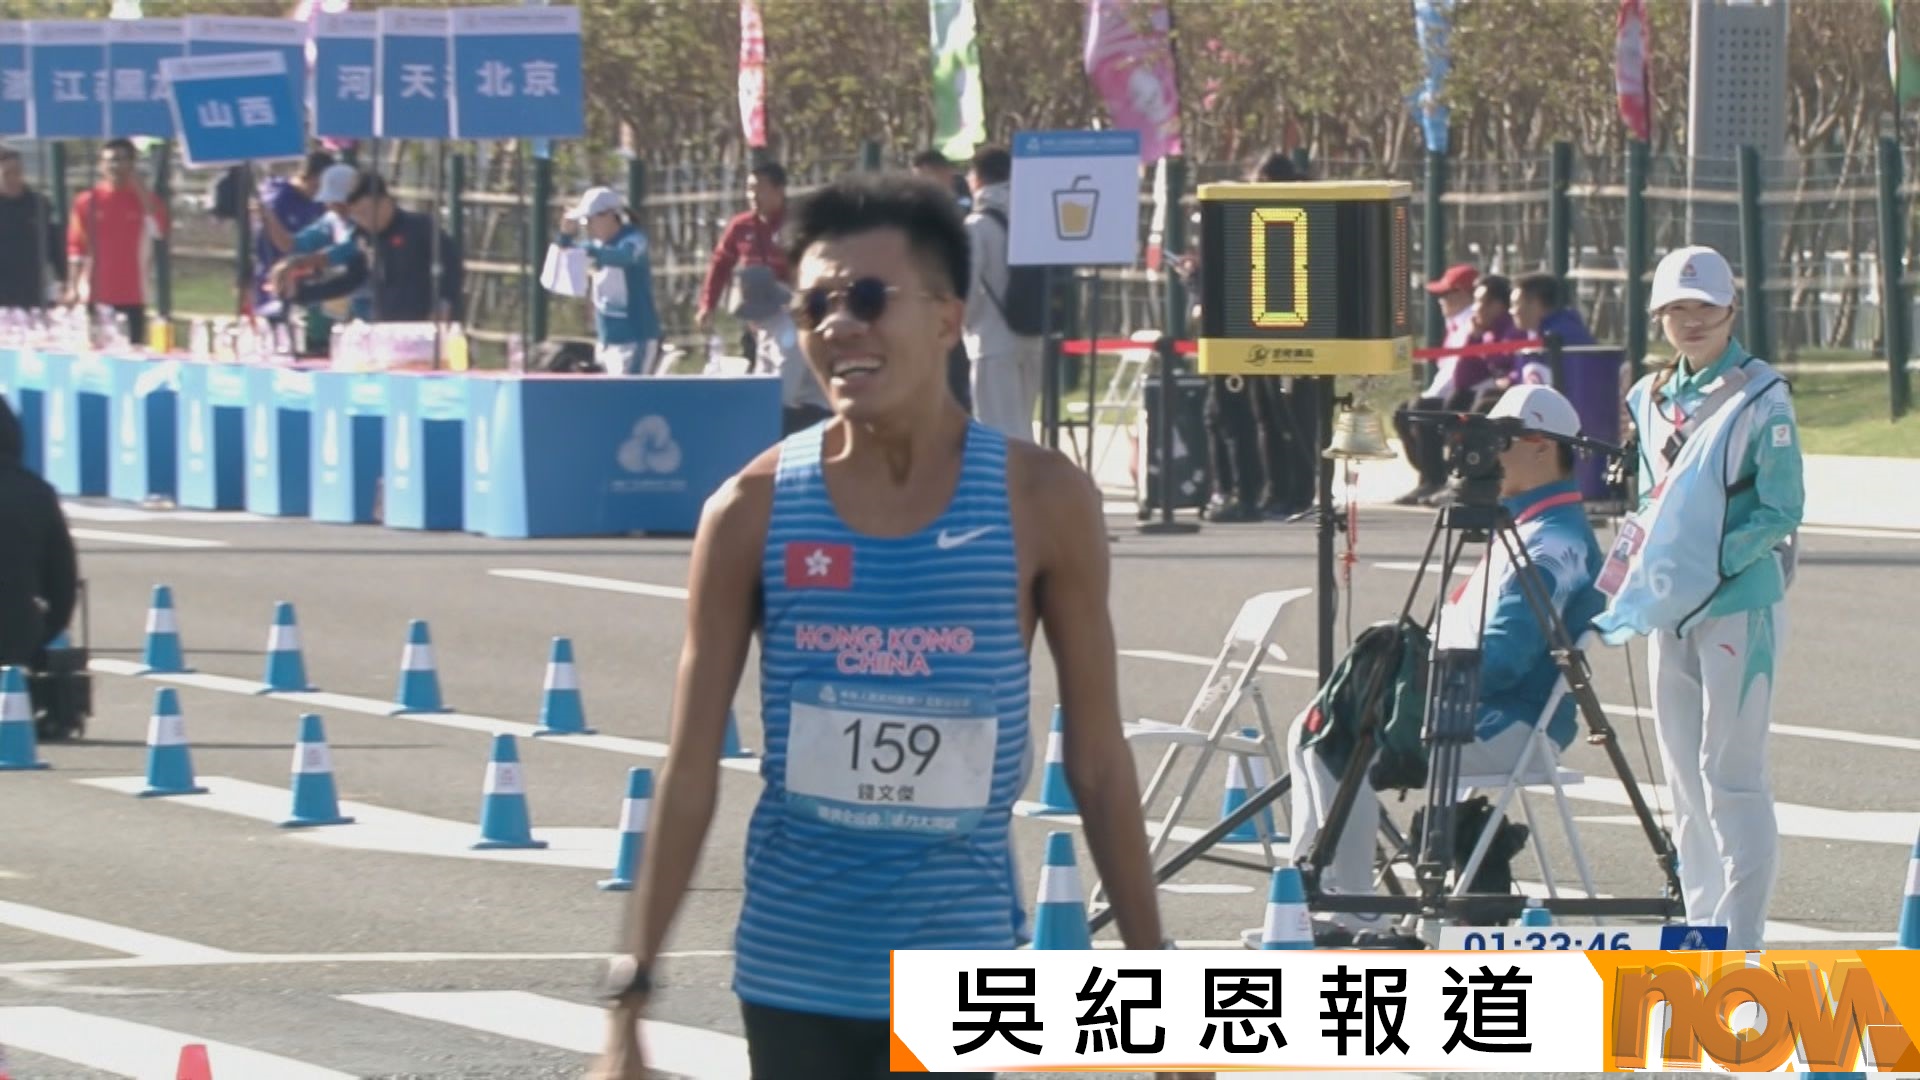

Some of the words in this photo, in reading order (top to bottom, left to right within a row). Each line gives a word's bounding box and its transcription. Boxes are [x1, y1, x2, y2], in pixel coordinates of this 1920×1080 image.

[401, 64, 450, 99] 天
[476, 60, 559, 97] 北京
[199, 97, 276, 127] 山西
[1251, 208, 1309, 328] 0
[796, 624, 883, 651] HONG
[888, 627, 974, 653] KONG
[836, 651, 932, 676] CHINA
[843, 718, 942, 777] 159
[857, 783, 916, 802] 錢文傑
